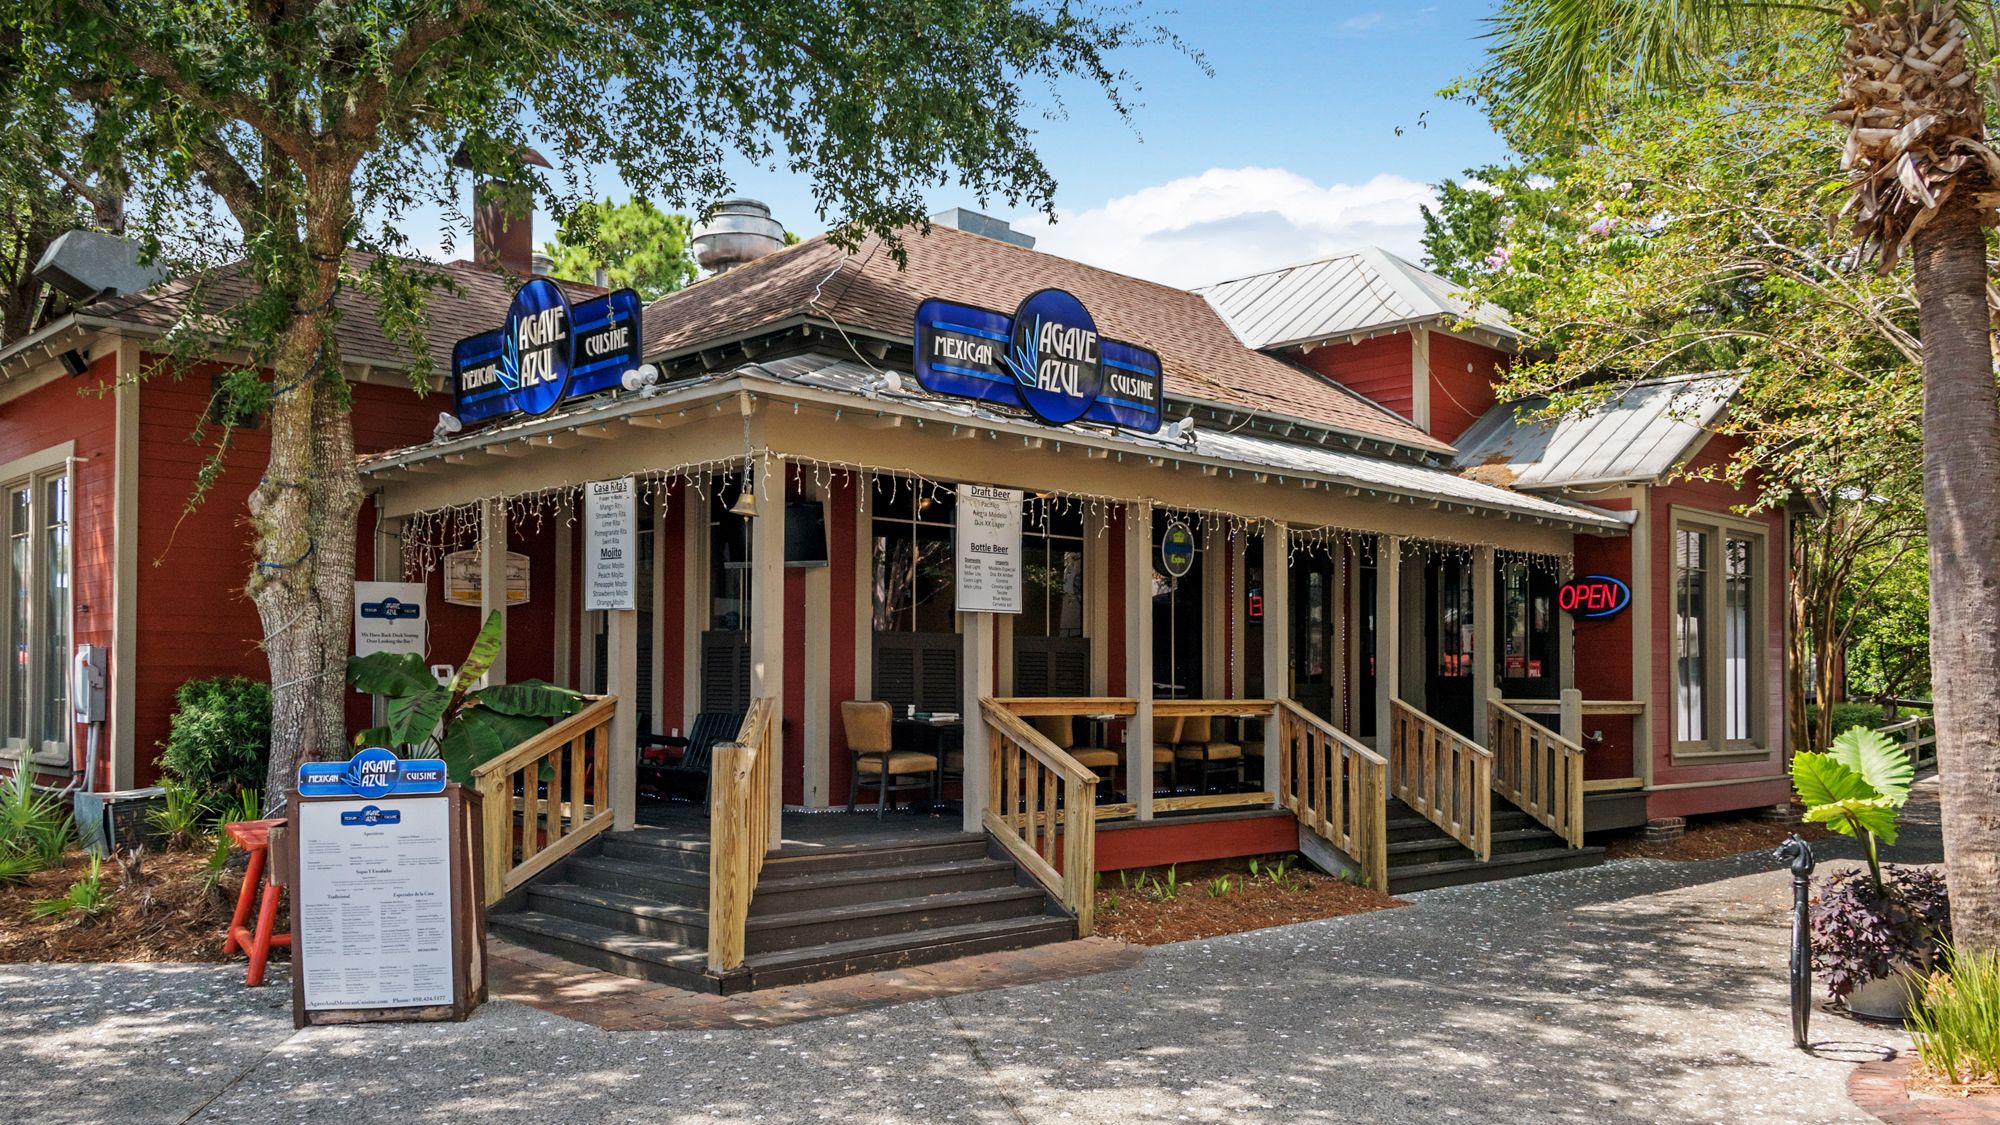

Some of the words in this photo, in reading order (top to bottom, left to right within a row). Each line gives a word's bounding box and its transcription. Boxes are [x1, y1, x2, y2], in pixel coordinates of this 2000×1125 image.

[519, 306, 566, 350] AGAVE
[1038, 322, 1096, 364] AGAVE
[462, 364, 497, 391] MEXICAN
[585, 327, 628, 356] CUISINE
[521, 348, 558, 388] AZUL
[934, 336, 992, 365] MEXICAN
[1110, 374, 1154, 400] CUISINE
[1038, 359, 1084, 398] AZUL
[594, 483, 609, 494] Casa
[610, 480, 627, 492] Rita's
[971, 486, 991, 497] Draft
[992, 488, 1010, 499] Beer
[601, 547, 622, 559] Mojito
[970, 542, 992, 552] Bottle
[993, 545, 1008, 553] Beer
[1559, 584, 1617, 610] OPEN
[362, 760, 396, 773] AGAVE
[308, 774, 338, 782] MEXICAN
[406, 772, 437, 780] CUISINE
[362, 774, 389, 787] AZUL
